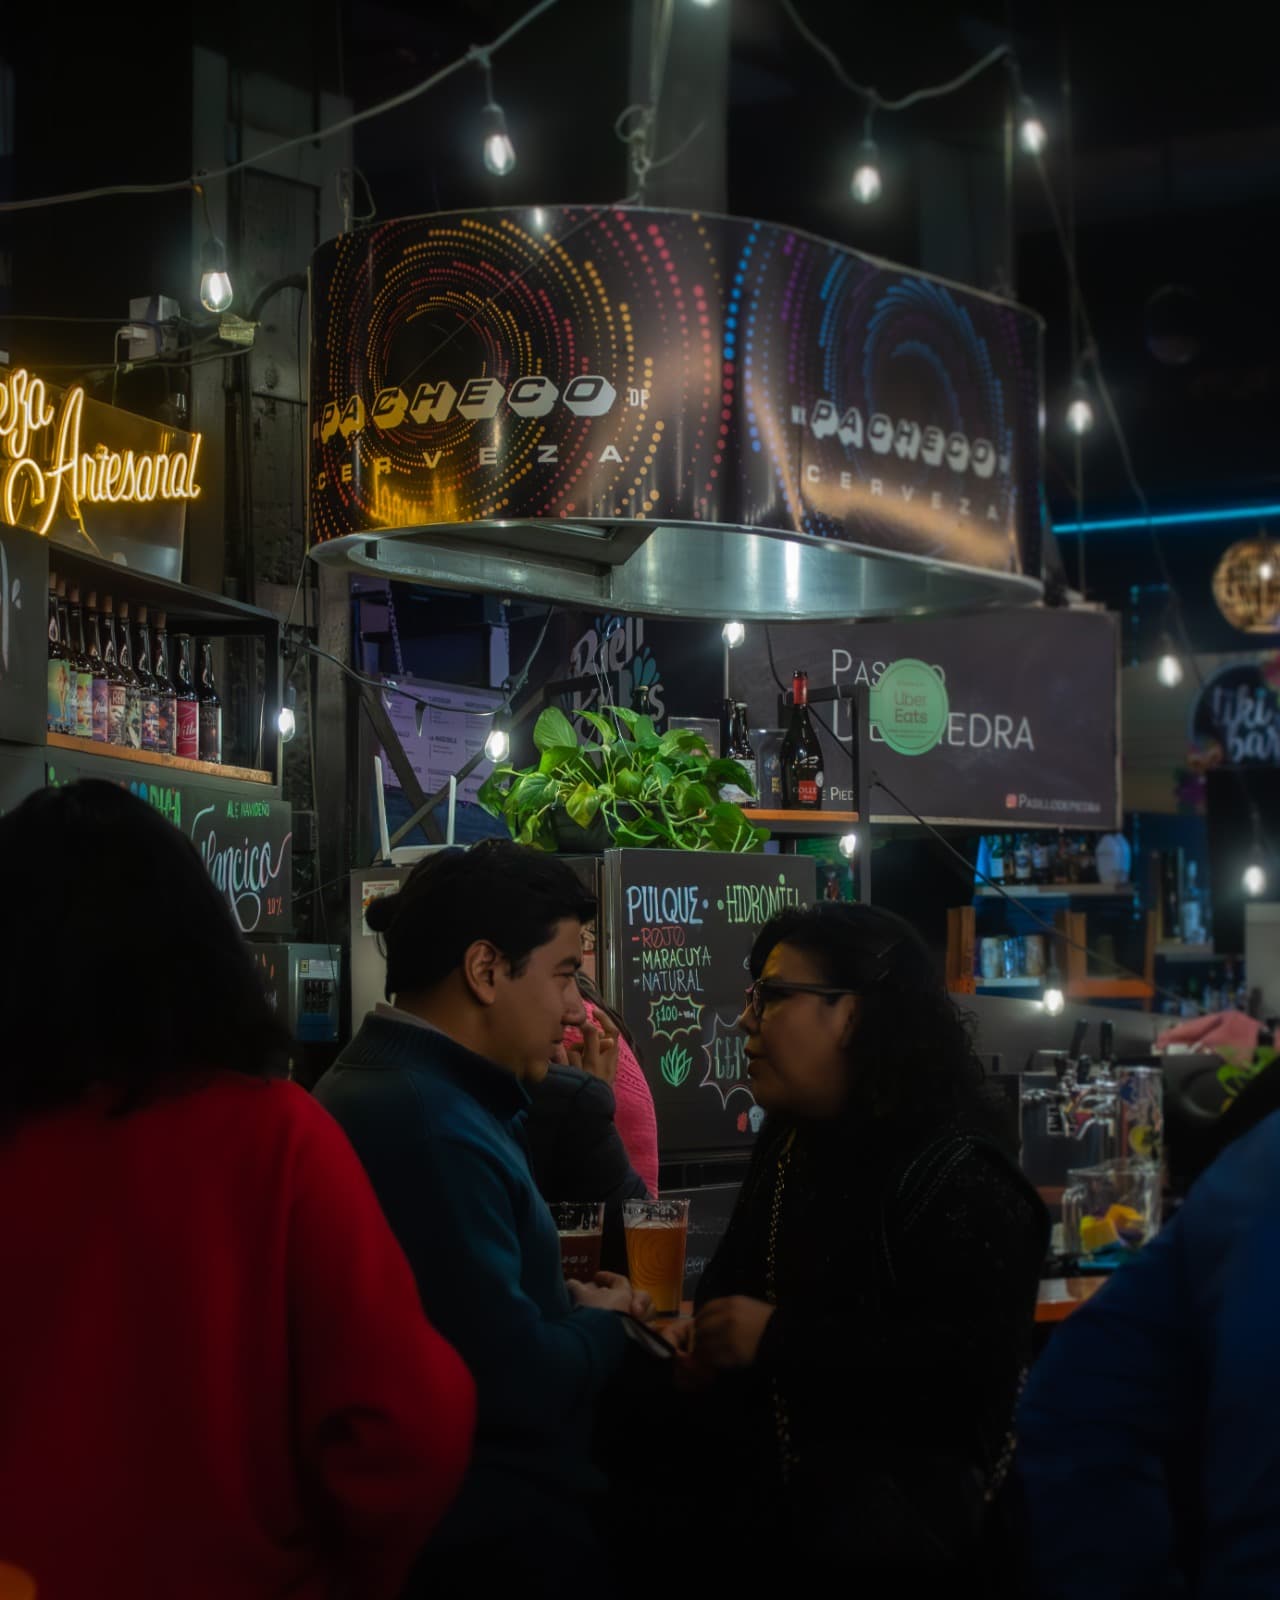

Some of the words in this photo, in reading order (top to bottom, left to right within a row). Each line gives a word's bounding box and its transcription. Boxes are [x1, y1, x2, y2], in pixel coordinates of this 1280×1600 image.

[320, 375, 616, 444] PACHECO
[7, 386, 202, 535] Artesanal
[810, 399, 996, 479] PACHECO
[317, 444, 623, 490] CERVEZA
[807, 464, 999, 521] CERVEZA
[894, 691, 928, 707] Uber
[894, 708, 928, 724] Eats
[626, 885, 704, 926] PULQUE
